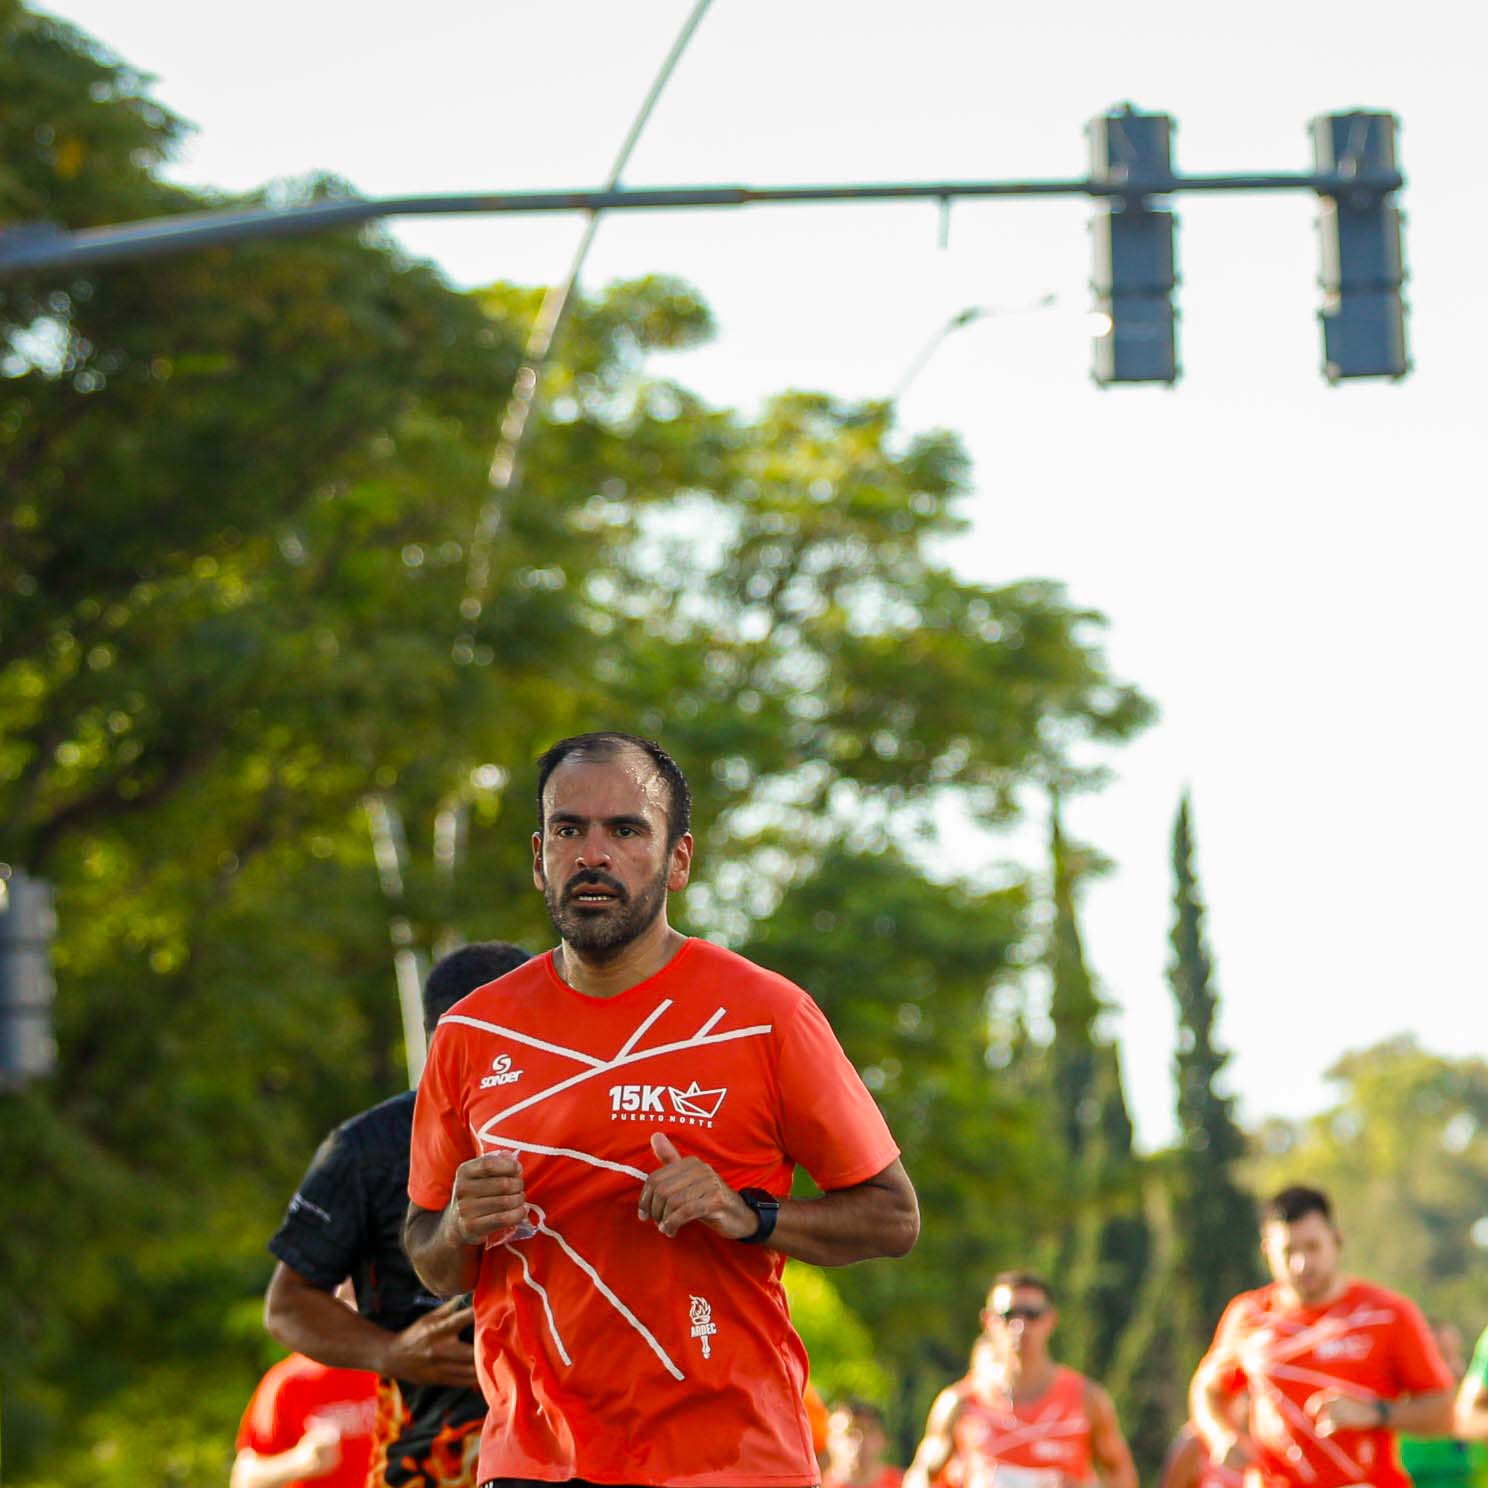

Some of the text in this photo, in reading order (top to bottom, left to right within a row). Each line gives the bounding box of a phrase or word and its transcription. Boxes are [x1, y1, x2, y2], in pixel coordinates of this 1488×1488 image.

[609, 1085, 666, 1112] 15K
[611, 1113, 713, 1128] PUERTO NORTE
